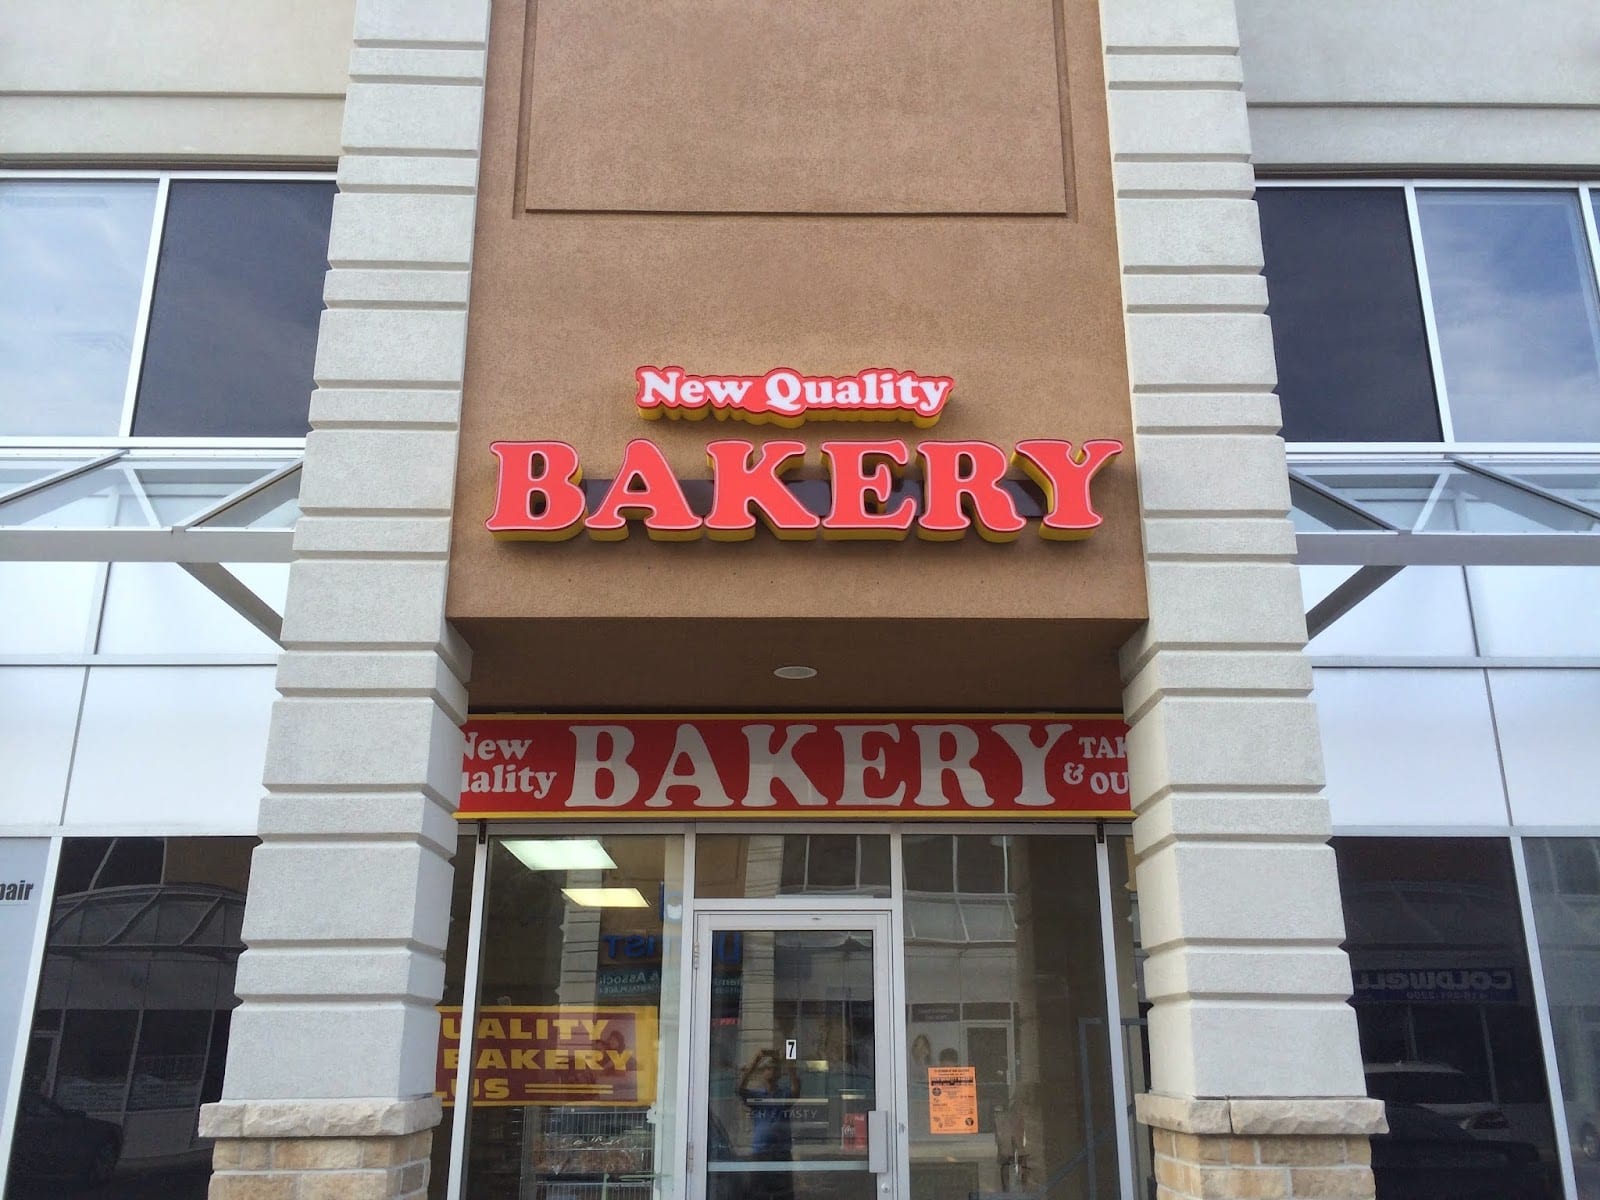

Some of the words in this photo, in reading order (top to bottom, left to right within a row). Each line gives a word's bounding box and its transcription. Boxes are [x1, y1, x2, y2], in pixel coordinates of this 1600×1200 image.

[641, 371, 751, 405] New
[764, 371, 950, 413] Quality
[485, 439, 1123, 533] BAKERY
[1078, 736, 1127, 759] TAK
[460, 764, 557, 799] ality
[564, 723, 1073, 807] BAKERY
[1063, 762, 1084, 785] &
[1090, 771, 1130, 795] OU
[442, 1018, 610, 1041] UALITY
[787, 1040, 796, 1058] 7
